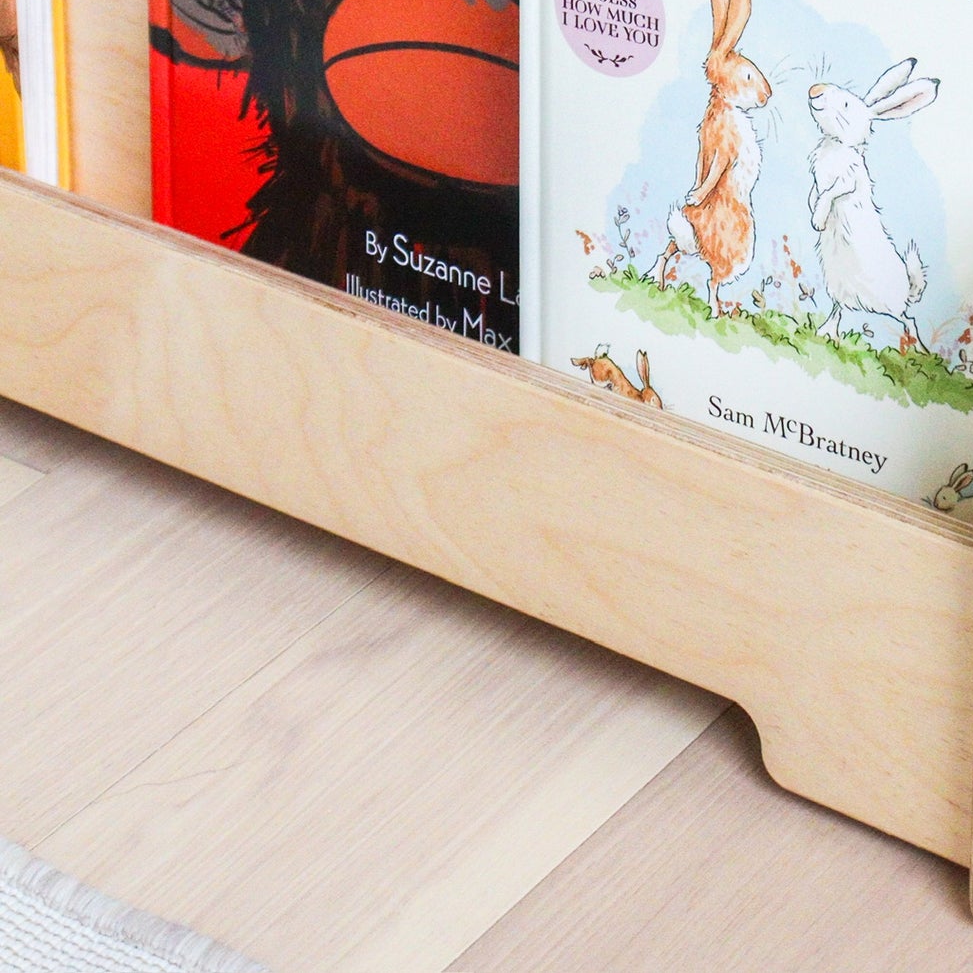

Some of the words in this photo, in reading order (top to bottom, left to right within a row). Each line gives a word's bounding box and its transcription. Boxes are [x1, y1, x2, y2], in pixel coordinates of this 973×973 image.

[562, 11, 569, 27] I
[574, 14, 620, 39] LOVE
[622, 26, 660, 48] YOU
[606, 7, 660, 32] MUCH
[365, 230, 388, 264] By
[392, 233, 492, 296] Suzanne
[345, 272, 431, 324] Illustrated
[435, 304, 457, 333] by
[463, 307, 513, 353] Max
[707, 394, 755, 429] Sam
[763, 411, 889, 474] McBratney
